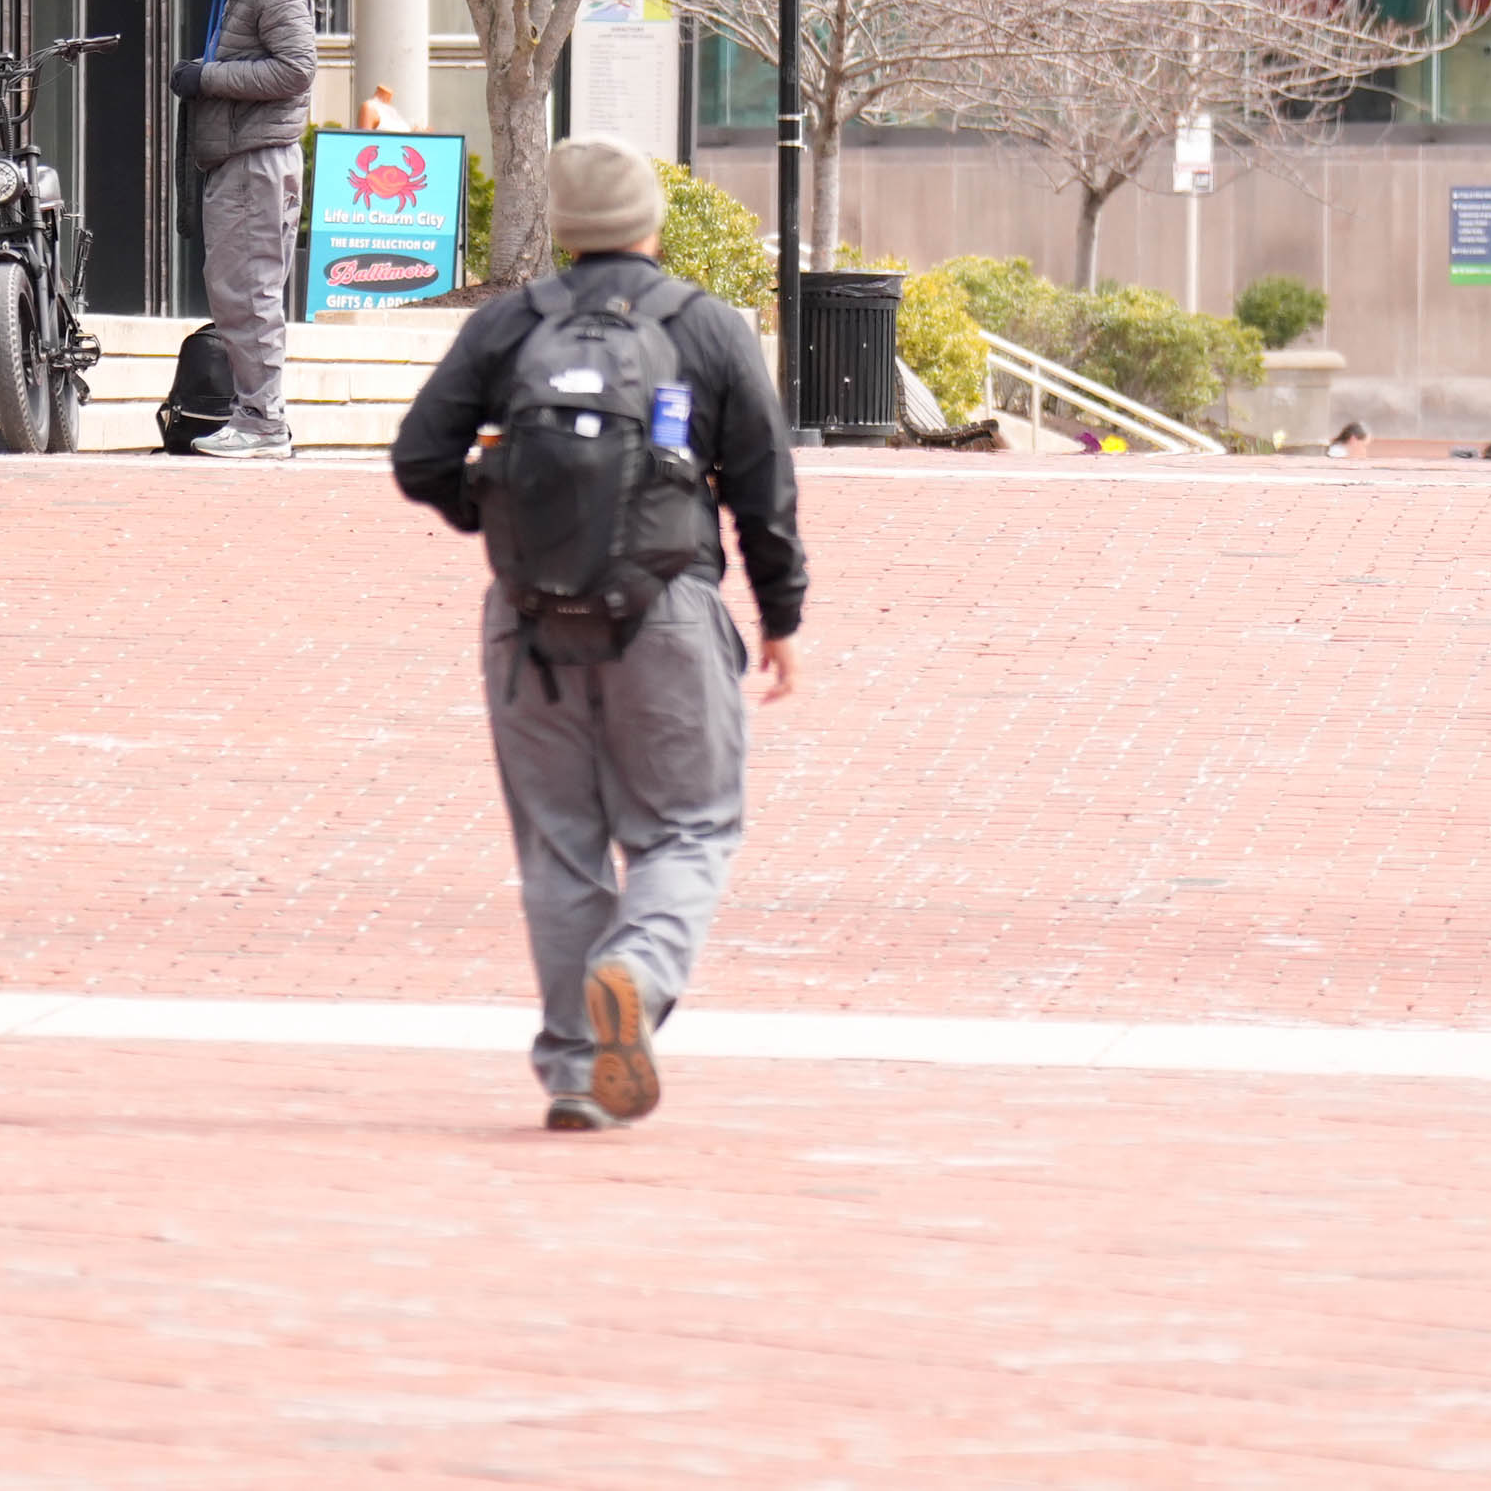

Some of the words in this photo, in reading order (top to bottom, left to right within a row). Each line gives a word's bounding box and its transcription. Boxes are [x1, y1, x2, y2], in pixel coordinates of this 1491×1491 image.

[324, 210, 349, 224] Life
[353, 211, 365, 224] in
[369, 211, 414, 226] Charm
[417, 213, 446, 230] City
[330, 237, 347, 248] THE
[349, 238, 370, 249] BEST
[371, 239, 421, 250] SELECTION
[422, 240, 437, 251] OF
[326, 259, 437, 287] Baltimore
[326, 294, 361, 309] GIFTS
[363, 295, 374, 309] &
